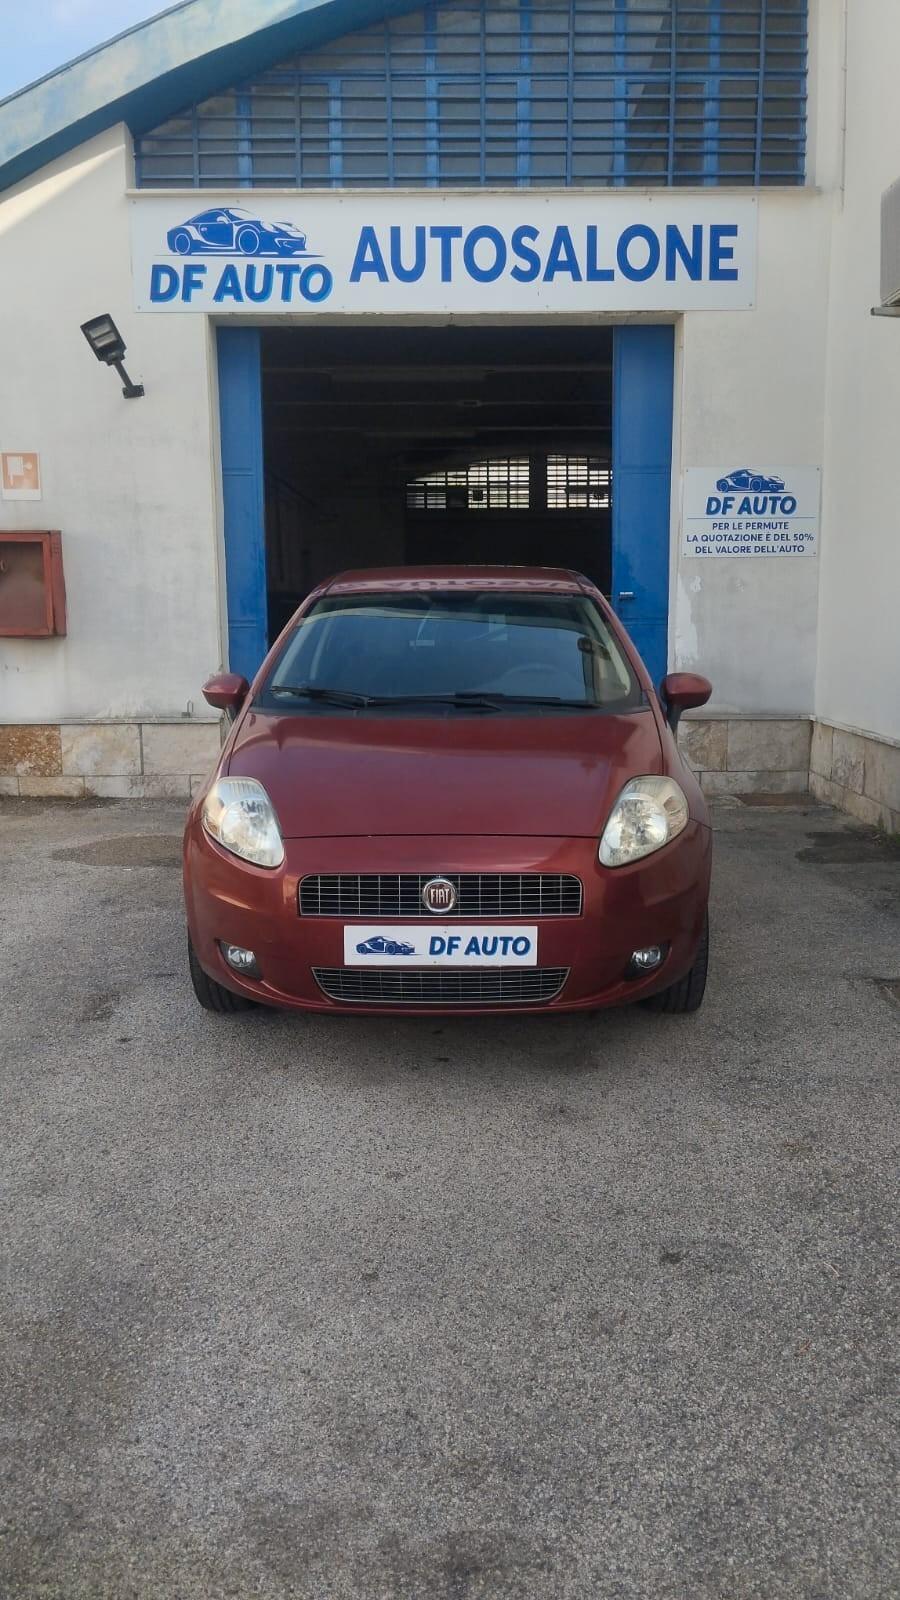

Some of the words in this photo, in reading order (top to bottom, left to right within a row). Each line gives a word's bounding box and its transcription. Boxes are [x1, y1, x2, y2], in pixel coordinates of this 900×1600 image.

[349, 224, 738, 283] AUTOSALONE
[150, 264, 207, 302] DF
[213, 264, 333, 302] AUTO
[706, 496, 735, 515] DF
[737, 496, 797, 515] AUTO
[712, 522, 730, 531] PER
[732, 522, 743, 530] LE
[745, 521, 789, 530] PERMUTE
[686, 535, 699, 543] LA
[700, 533, 763, 543] QUOTAZIONE
[773, 533, 791, 541] DEL
[793, 533, 814, 541] 50%
[695, 545, 713, 554] DEL
[715, 545, 752, 554] VALORE
[754, 544, 805, 553] DELL'AUTO
[430, 888, 450, 904] FIAT
[429, 936, 461, 956] DF
[463, 936, 531, 956] AUTO
